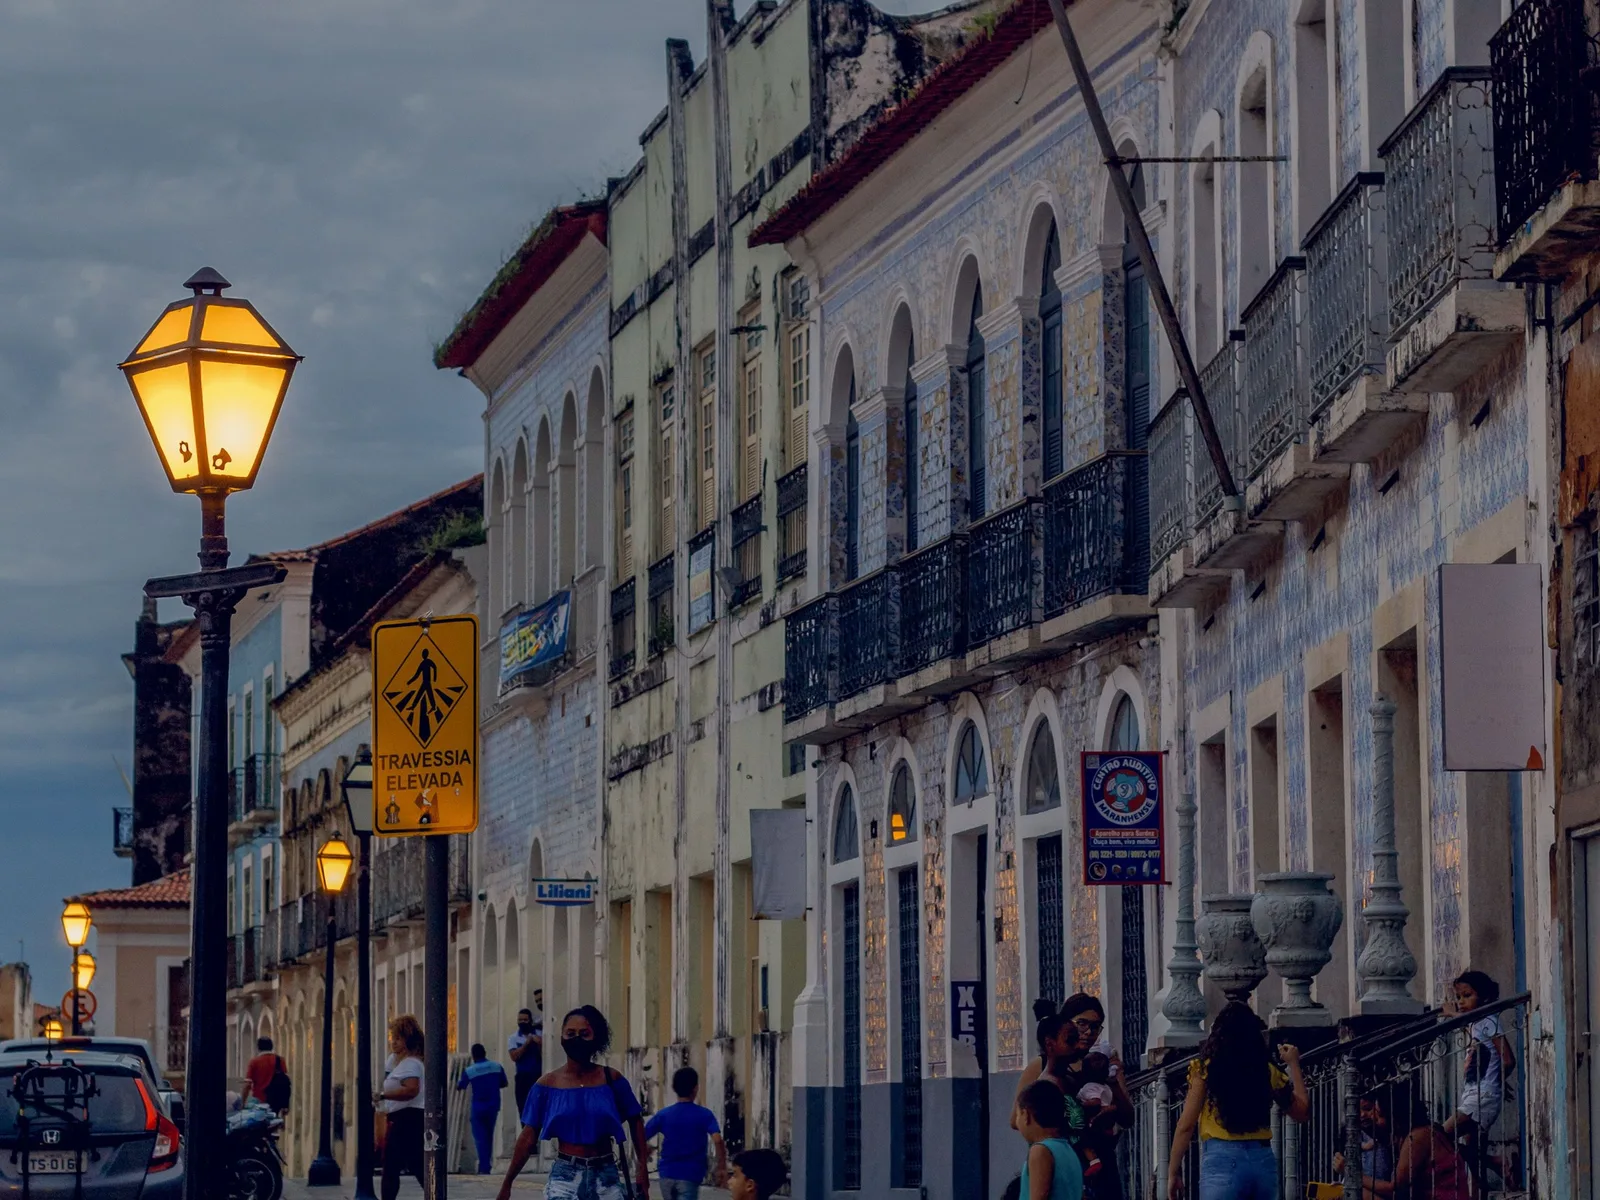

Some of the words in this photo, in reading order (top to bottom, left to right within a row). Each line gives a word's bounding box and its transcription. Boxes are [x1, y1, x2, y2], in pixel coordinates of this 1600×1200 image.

[379, 749, 471, 770] TRAVESSIA
[386, 771, 463, 791] ELEVADA
[1093, 759, 1121, 791] CENTRO
[1122, 759, 1158, 791] AUDITIVO
[1098, 801, 1154, 823] MARANHENSE
[537, 884, 591, 898] Liliani
